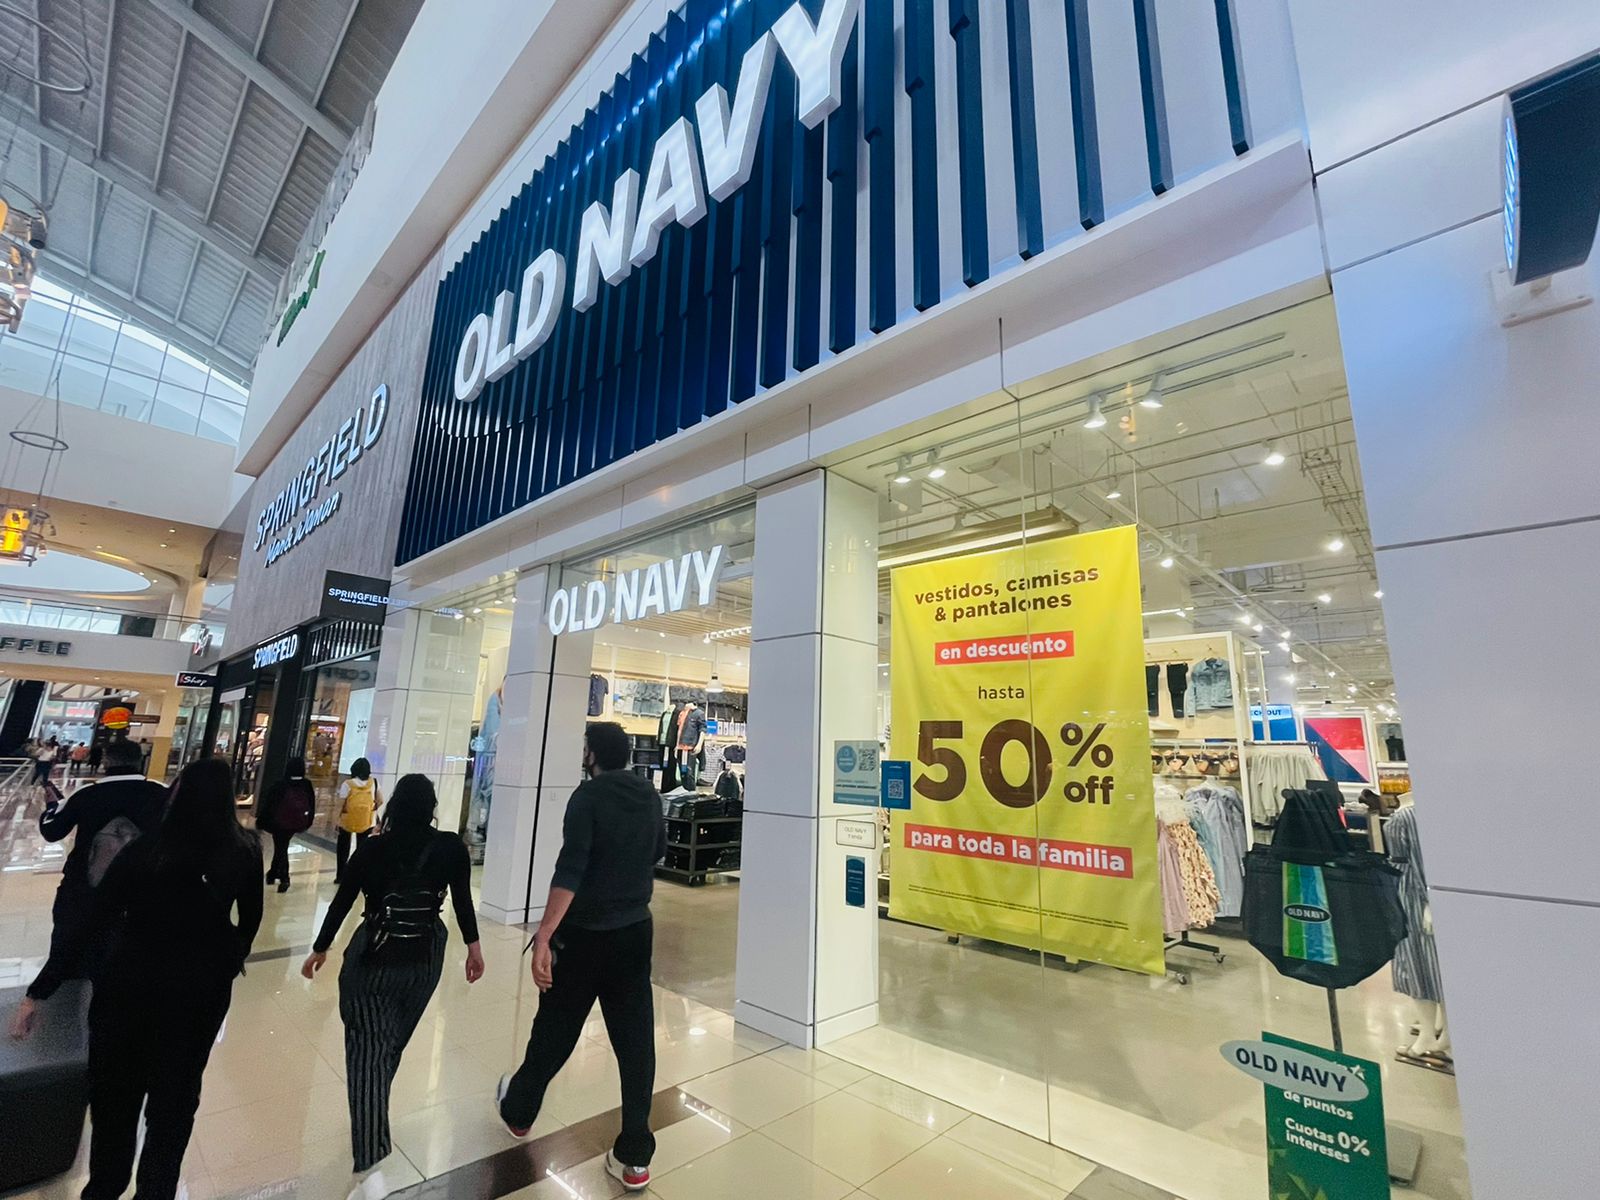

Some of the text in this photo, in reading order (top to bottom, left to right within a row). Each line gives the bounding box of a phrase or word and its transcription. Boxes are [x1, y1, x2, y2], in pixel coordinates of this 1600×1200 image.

[454, 248, 566, 402] OLD
[572, 0, 860, 314] NAVY
[253, 383, 392, 552] SPRINGFIELD
[328, 587, 389, 604] SPRINGFIELD
[548, 545, 723, 636] OLD NAVY
[914, 567, 1099, 605] vestidos, camisas
[934, 593, 1073, 623] & pantalones
[940, 637, 1067, 660] en descuento
[978, 685, 1025, 700] hasta
[1063, 775, 1114, 805] off
[911, 830, 1125, 872] para toda la familia
[1287, 907, 1303, 917] OLD
[1235, 1047, 1347, 1093] OLD NAVY
[1303, 1097, 1354, 1121] puntos
[1284, 1117, 1371, 1157] Cuotas 0%
[1285, 1130, 1351, 1164] intereses
